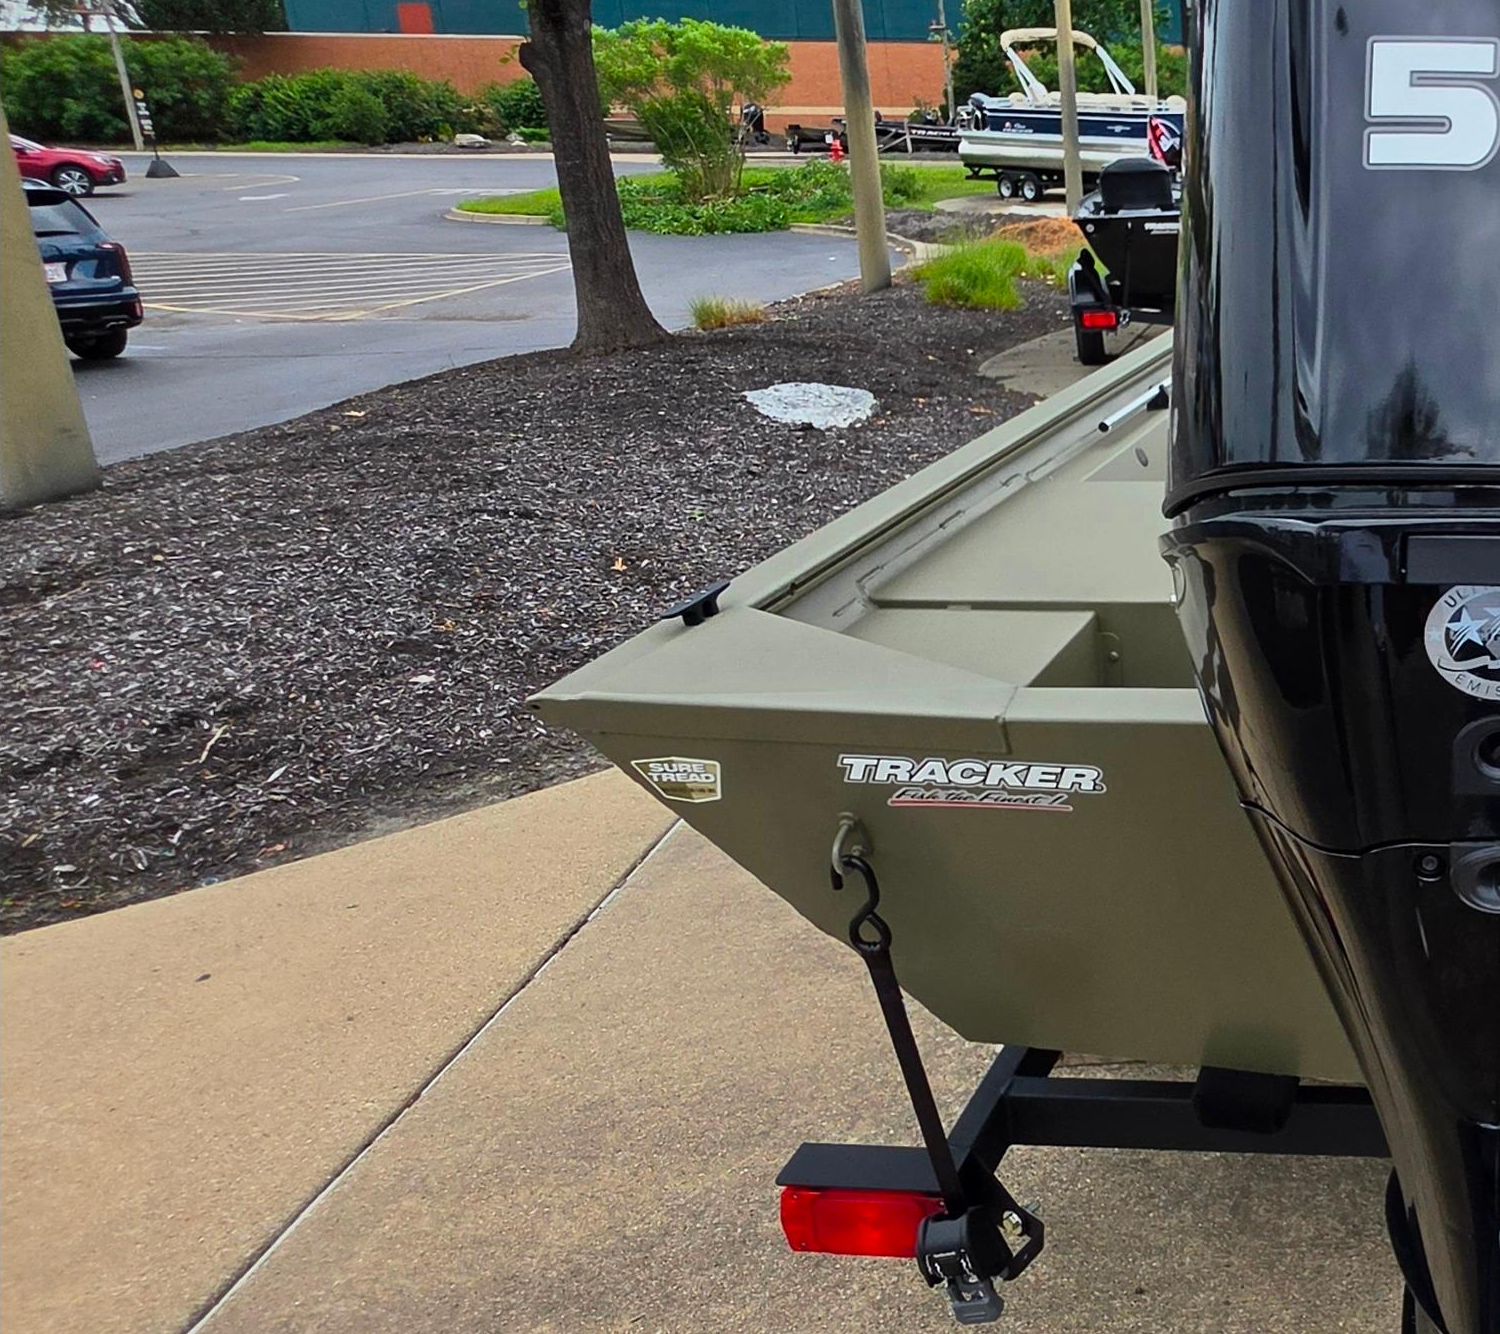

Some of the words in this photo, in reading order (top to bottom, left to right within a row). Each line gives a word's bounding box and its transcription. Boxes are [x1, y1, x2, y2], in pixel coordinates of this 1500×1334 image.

[648, 762, 706, 774] SURE
[840, 757, 1101, 792] TRACKER
[647, 772, 716, 783] TREAD
[895, 788, 940, 801] Fish
[943, 789, 975, 802] the
